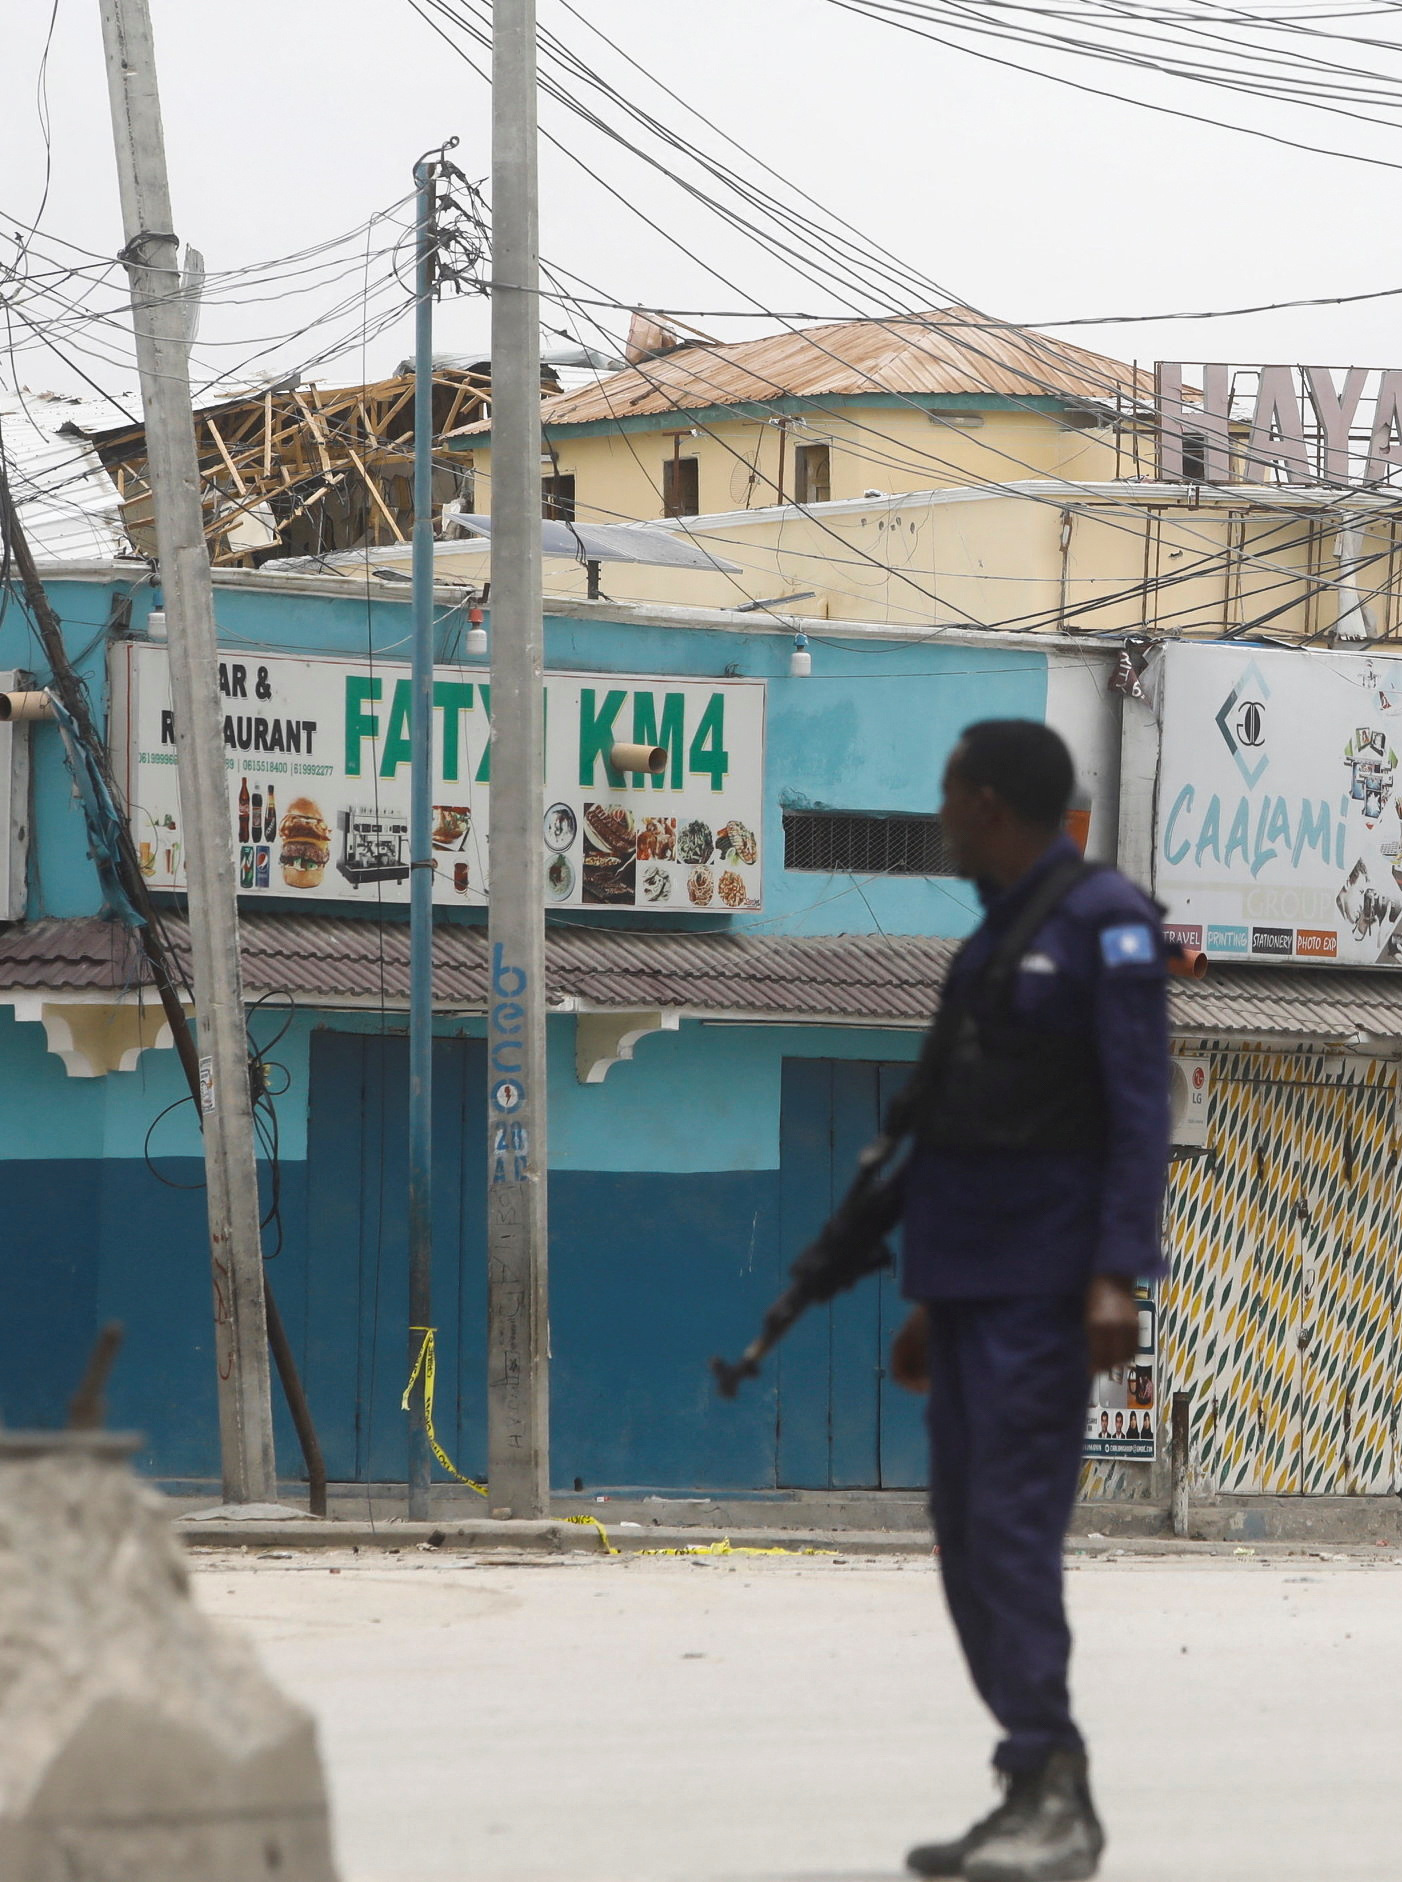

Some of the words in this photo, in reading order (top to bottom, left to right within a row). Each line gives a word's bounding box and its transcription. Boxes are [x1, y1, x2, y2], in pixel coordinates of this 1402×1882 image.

[219, 662, 248, 699] AR
[255, 665, 272, 700] &
[579, 688, 730, 794] KM4
[1163, 930, 1200, 945] TRAVEL
[1207, 930, 1247, 947] PRINTING
[1253, 932, 1293, 950] STATIONERY
[1297, 937, 1321, 950] PHOTO
[1323, 937, 1337, 951] EXP
[492, 942, 527, 1115] beco
[1192, 1092, 1202, 1105] LG
